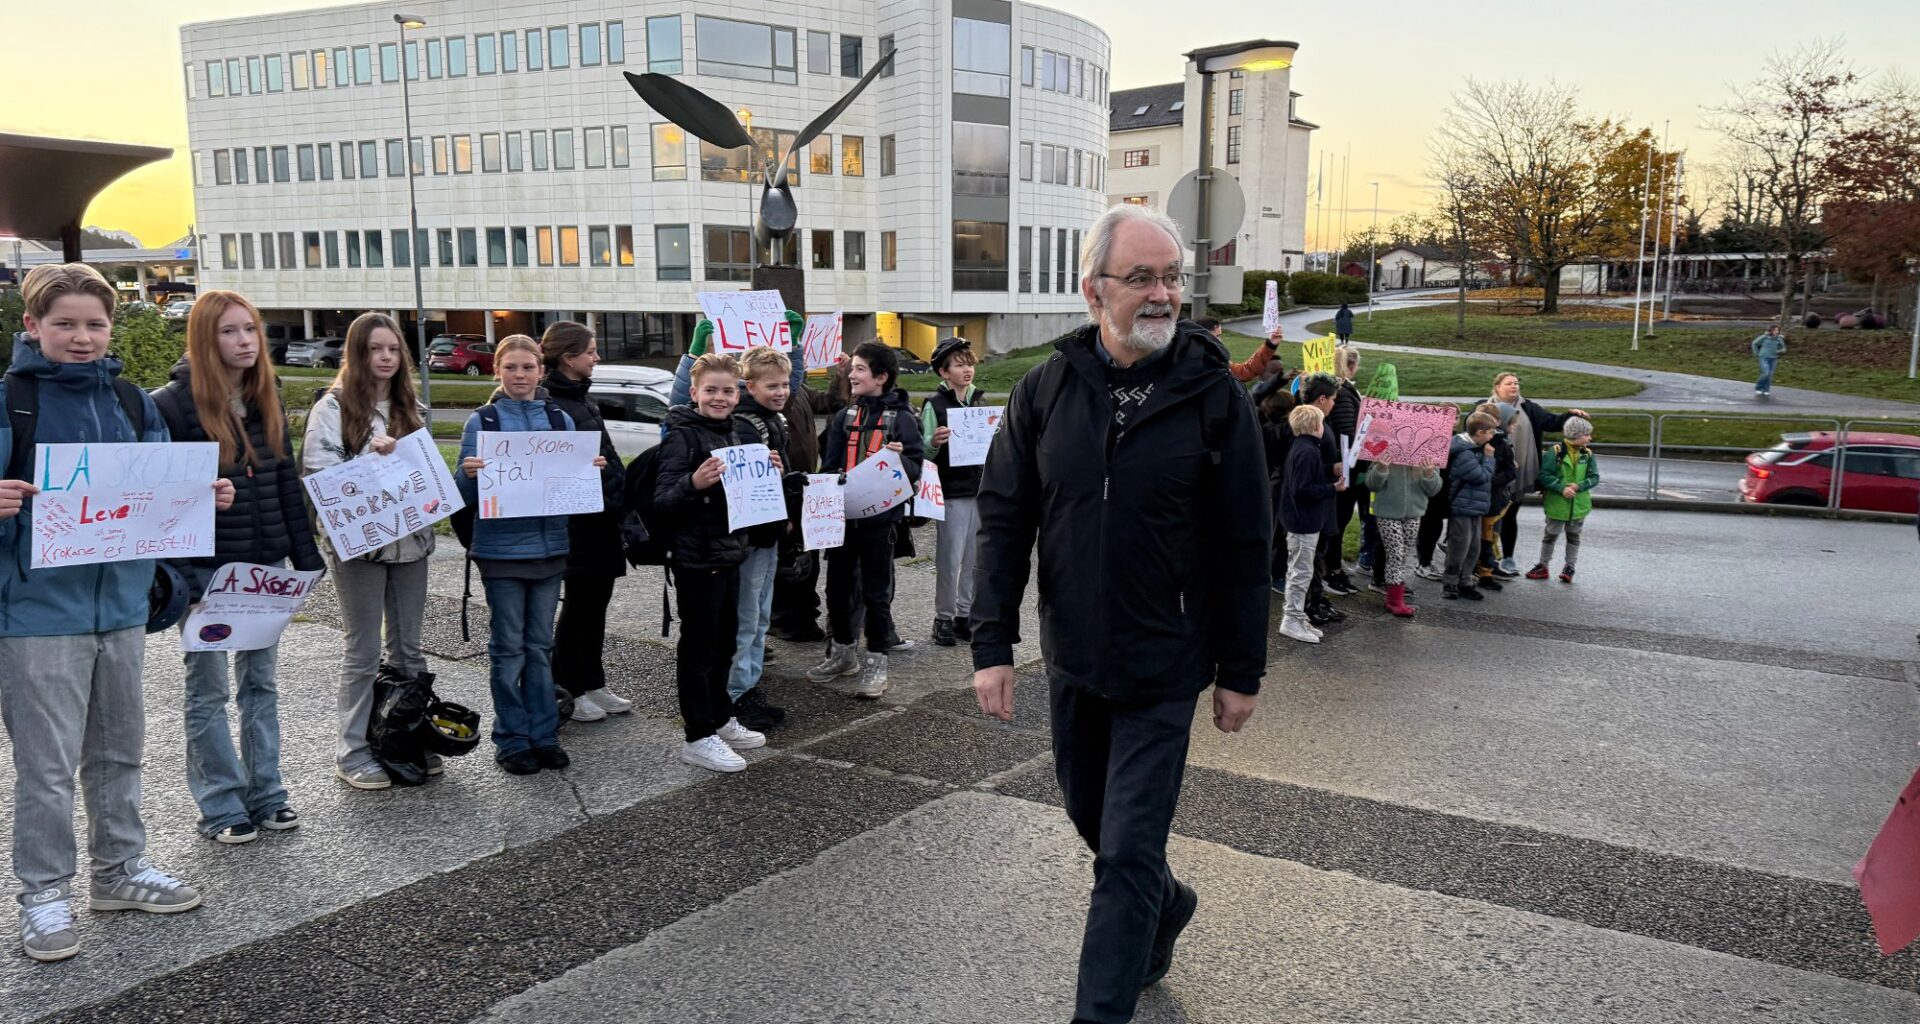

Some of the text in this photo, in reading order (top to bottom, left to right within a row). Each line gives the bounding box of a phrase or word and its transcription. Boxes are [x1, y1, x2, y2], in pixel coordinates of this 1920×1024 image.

[705, 299, 738, 316] LA
[717, 318, 790, 349] LEVE
[42, 446, 91, 491] LA
[340, 506, 423, 556] LEVE
[103, 546, 128, 559] er
